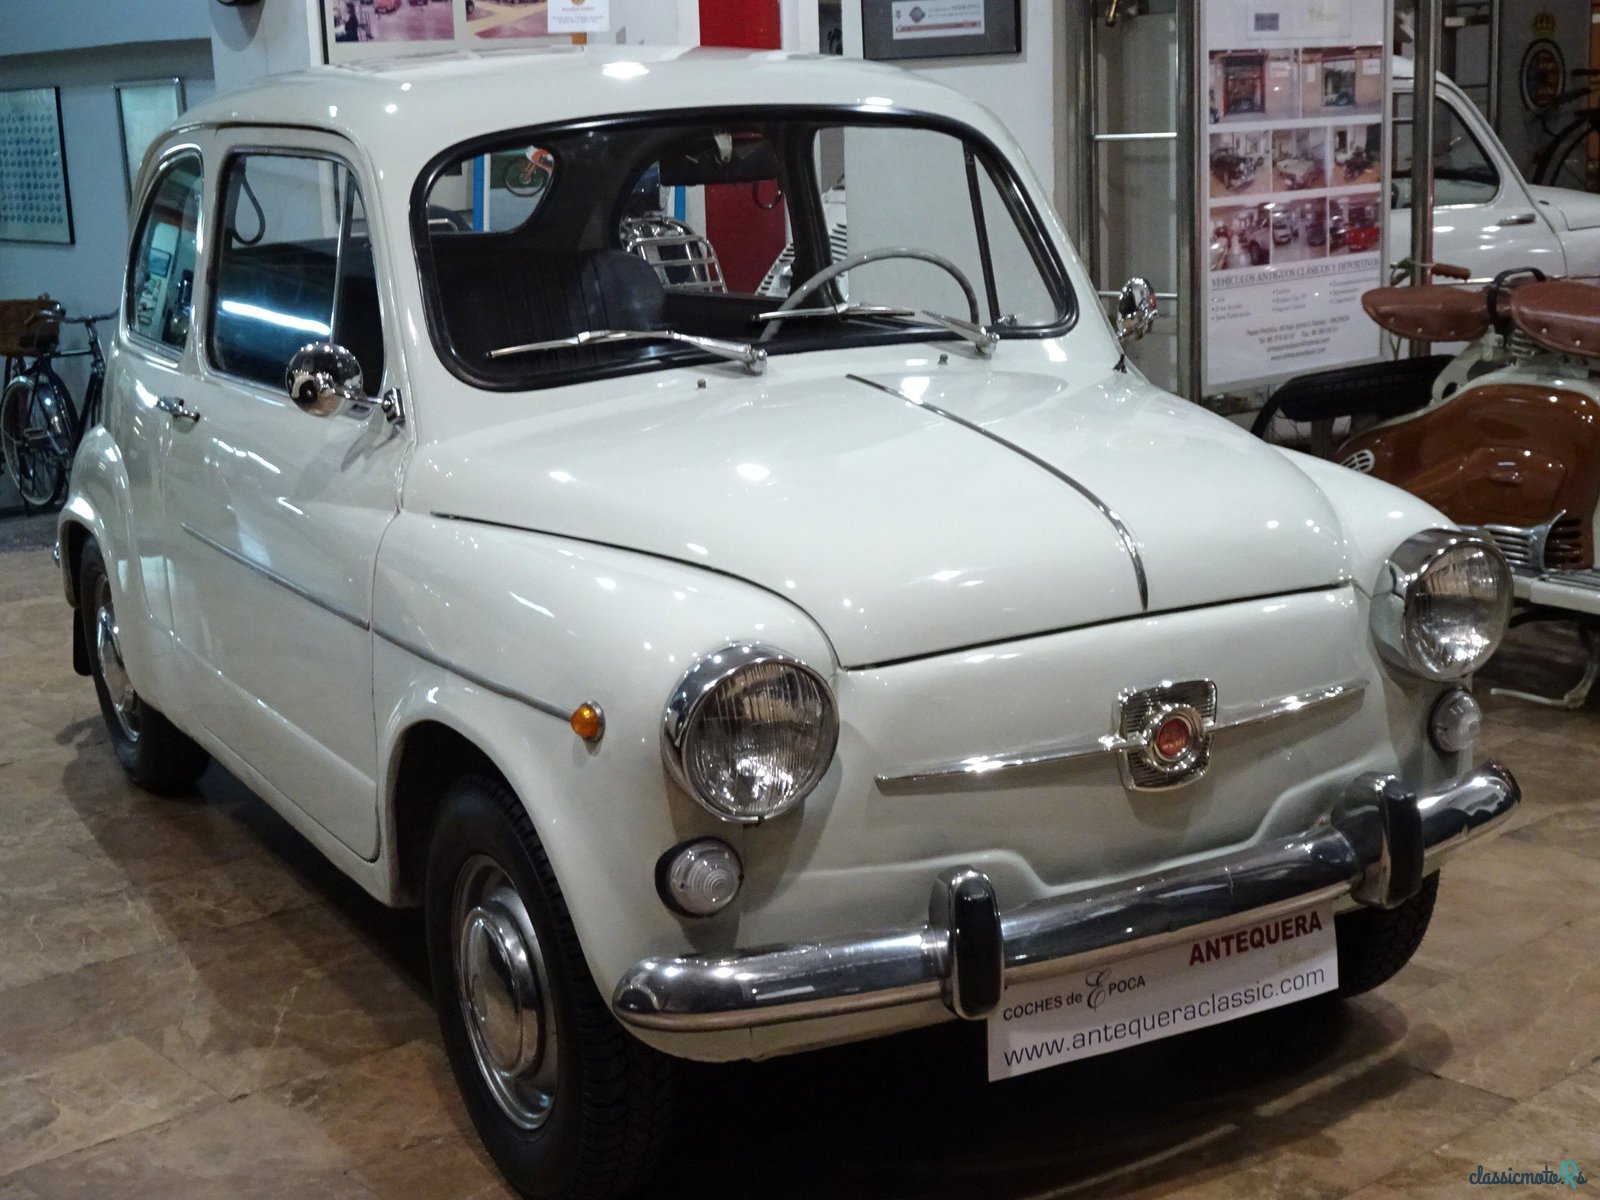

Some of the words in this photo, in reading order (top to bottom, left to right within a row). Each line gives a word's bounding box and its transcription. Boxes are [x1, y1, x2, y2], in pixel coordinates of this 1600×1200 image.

[1189, 911, 1323, 967] ANTEQUERA
[1003, 995, 1063, 1021] COCHES
[1066, 992, 1083, 1007] de
[1003, 966, 1325, 1067] www.antequeraclassic.com
